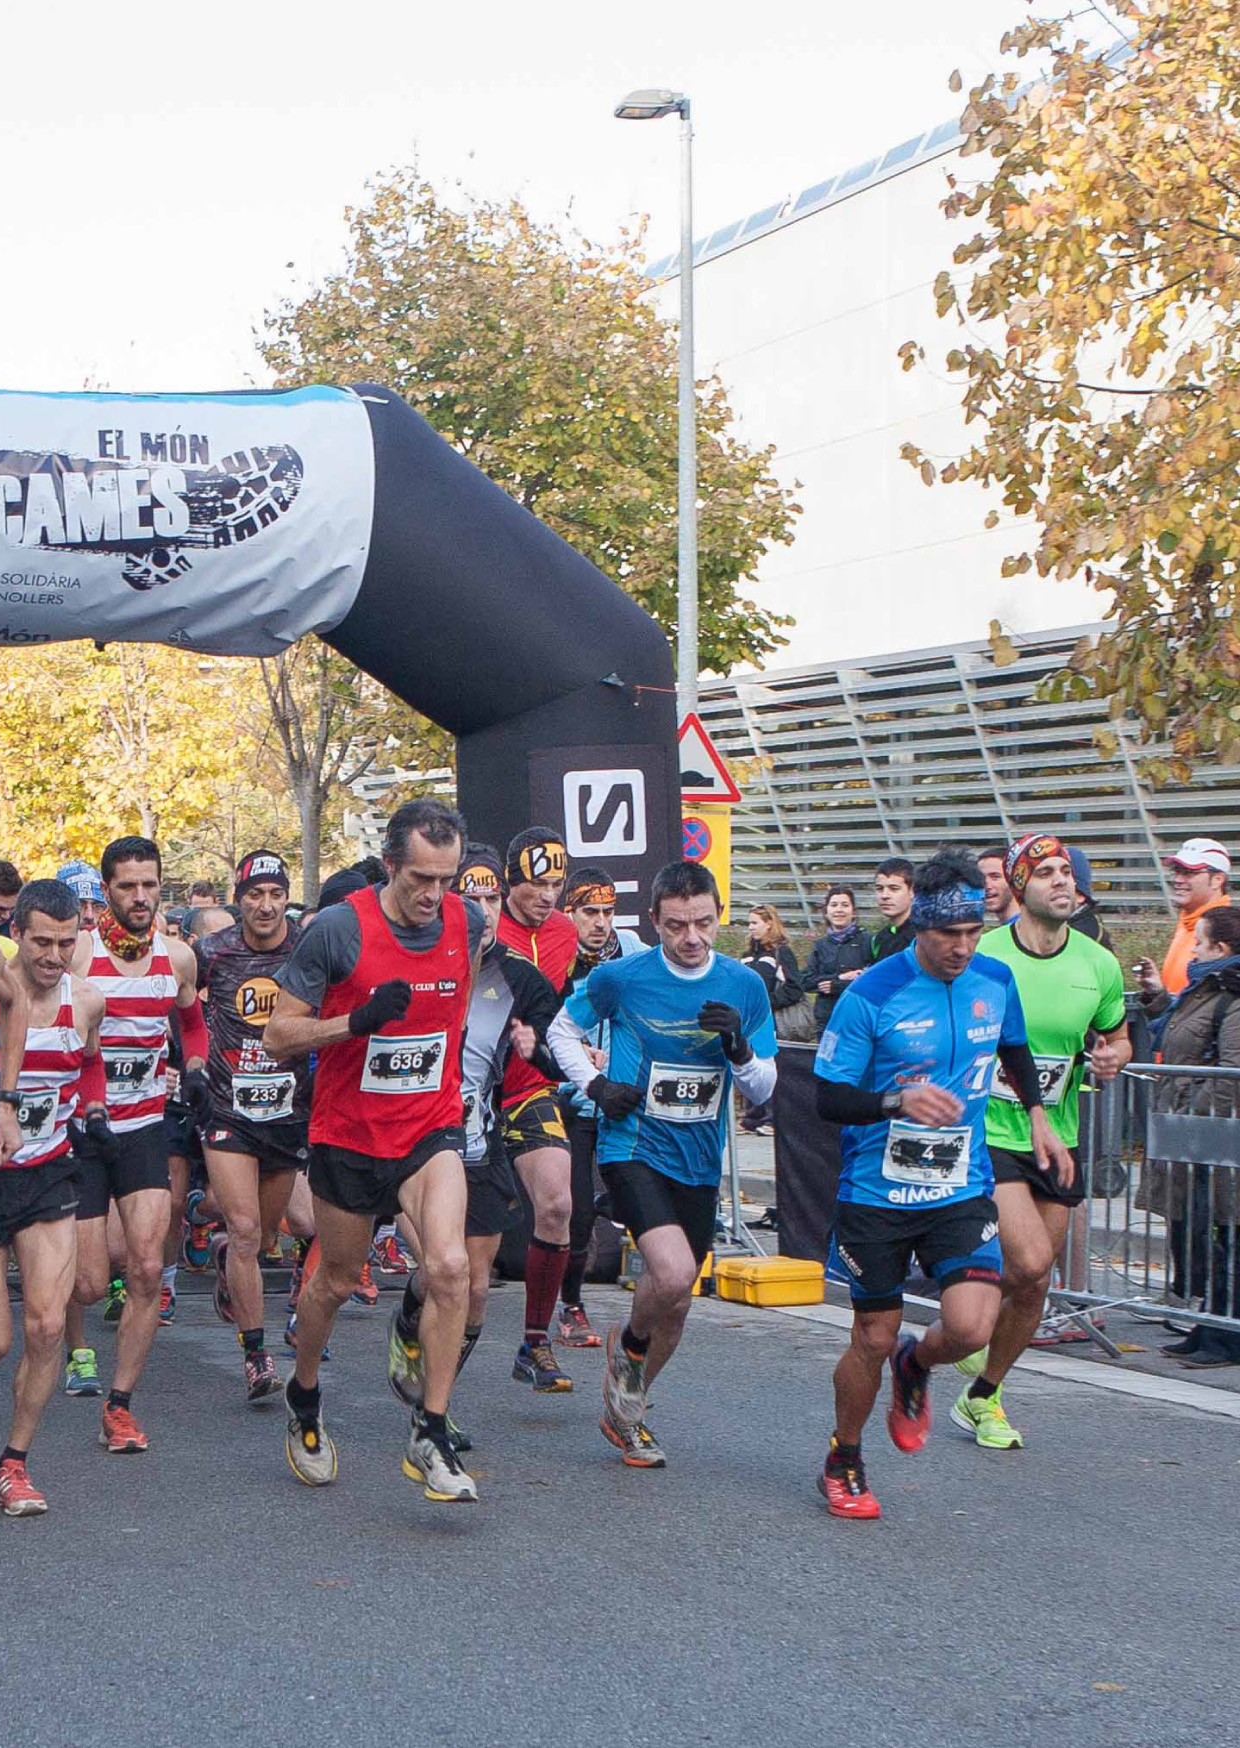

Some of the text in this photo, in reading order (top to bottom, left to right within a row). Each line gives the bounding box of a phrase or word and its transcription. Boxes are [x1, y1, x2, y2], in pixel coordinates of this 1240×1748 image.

[97, 425, 210, 466] EL MÓN
[0, 569, 82, 589] SOLIDÀRIA
[415, 983, 436, 992] CLUB
[114, 1062, 133, 1076] 10
[389, 1052, 423, 1070] 636
[250, 1088, 279, 1102] 233
[676, 1082, 699, 1099] 83
[921, 1144, 935, 1161] 4
